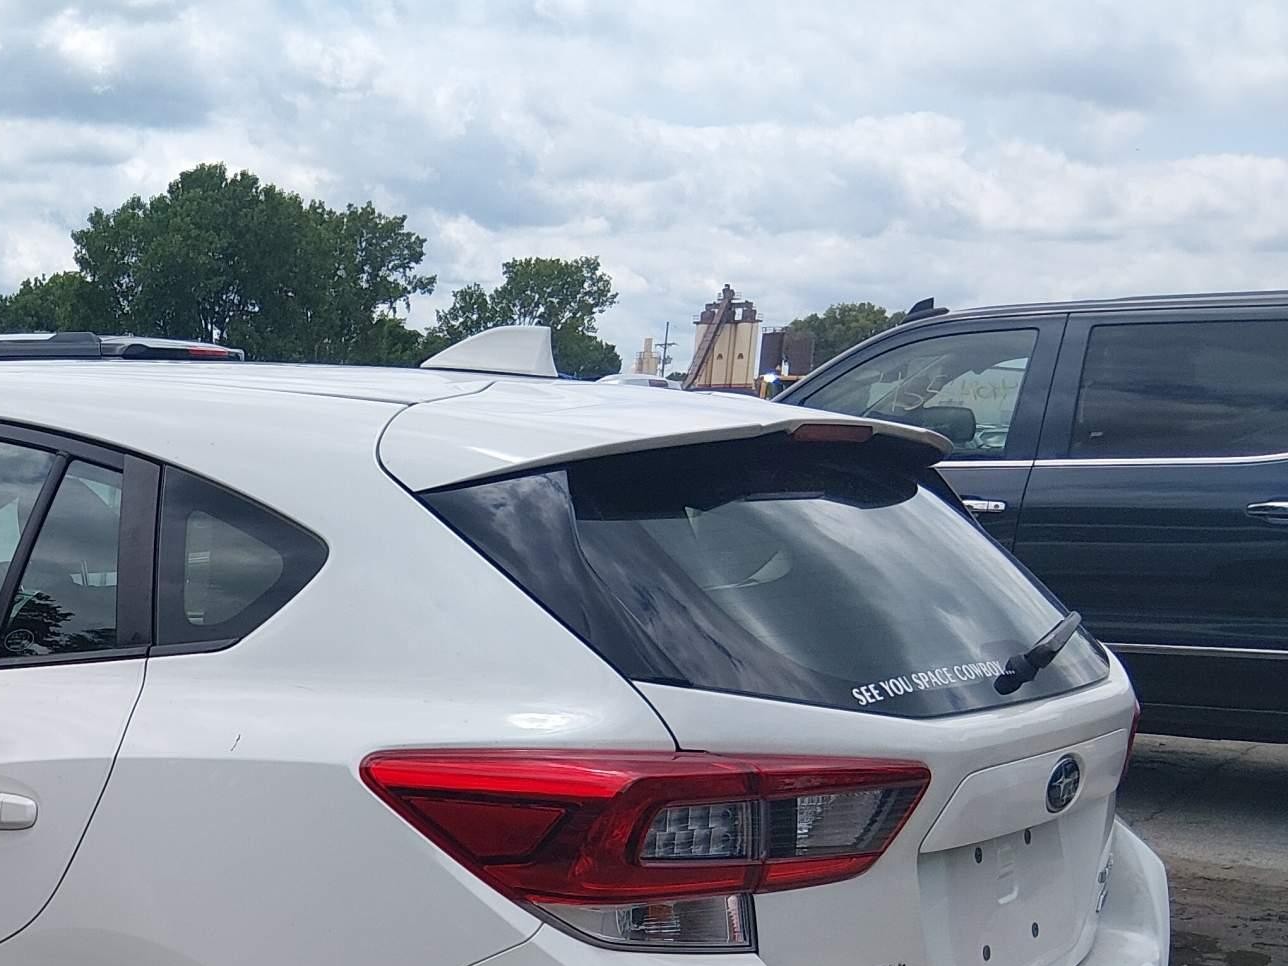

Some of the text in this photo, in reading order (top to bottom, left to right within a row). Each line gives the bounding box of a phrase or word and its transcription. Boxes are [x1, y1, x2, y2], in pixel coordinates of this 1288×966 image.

[852, 683, 884, 706] SEE
[879, 675, 913, 697] YOU
[911, 667, 956, 690] SPACE
